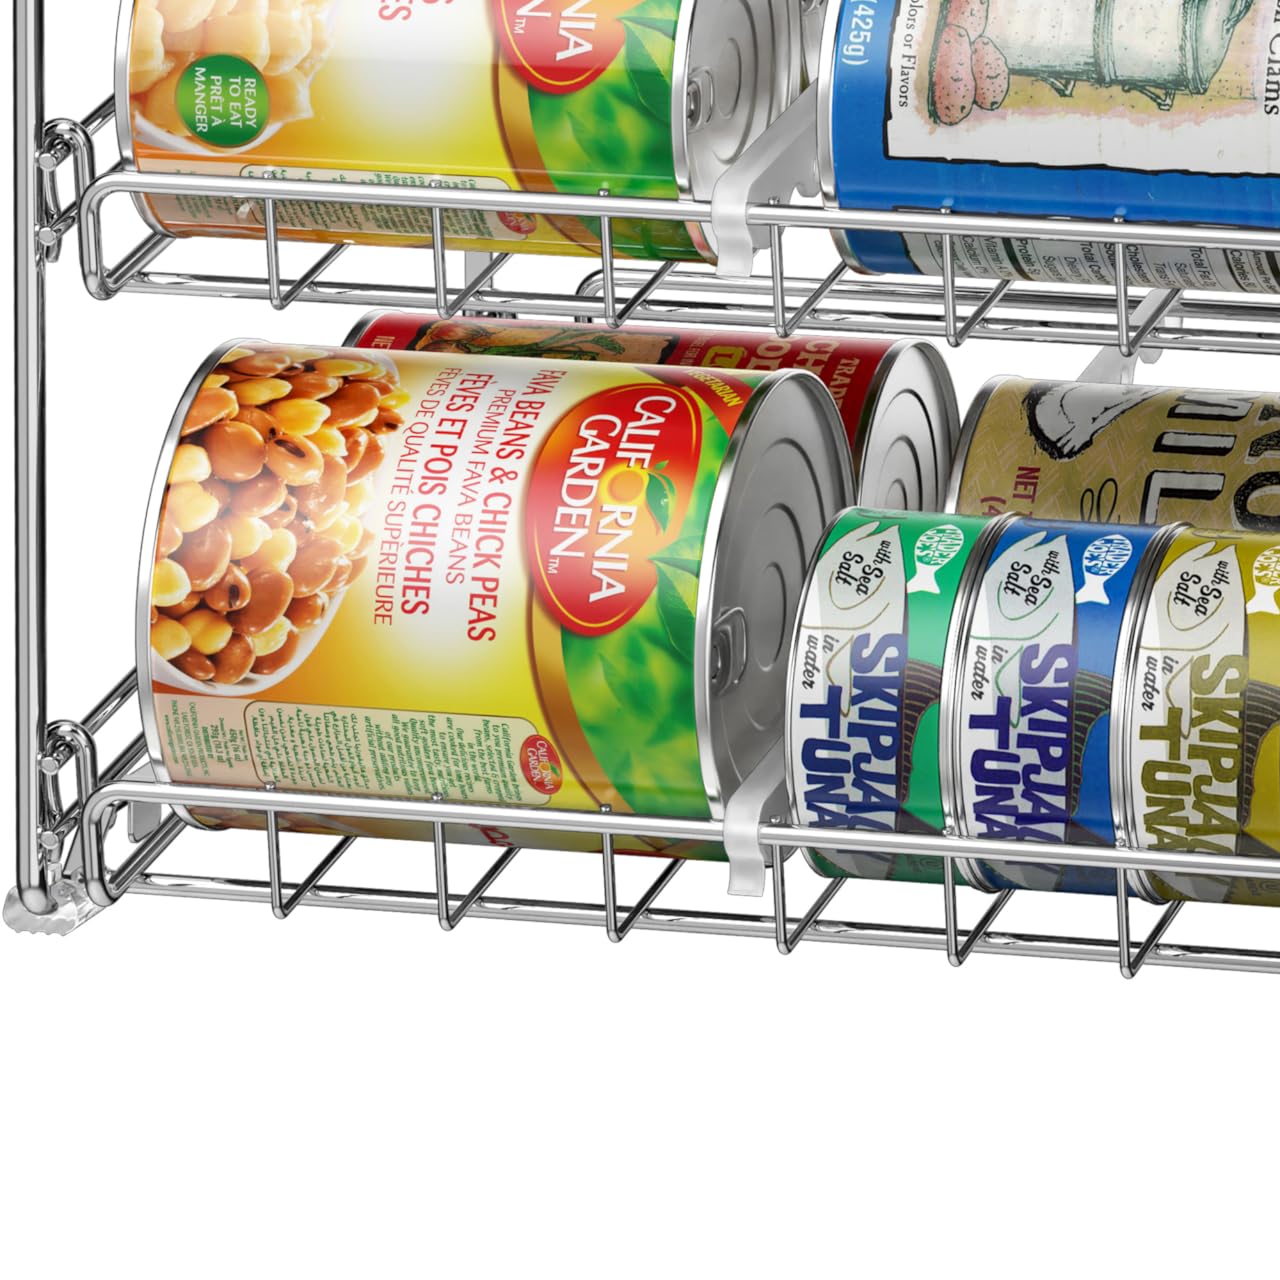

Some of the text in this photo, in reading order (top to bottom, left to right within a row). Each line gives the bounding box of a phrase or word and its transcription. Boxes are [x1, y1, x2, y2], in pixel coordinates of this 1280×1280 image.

[902, 34, 914, 49] or
[194, 66, 209, 133] MANGER
[209, 75, 224, 116] PRÊT
[228, 76, 243, 128] TO EAT
[243, 77, 259, 128] READY
[898, 54, 918, 108] Flavors
[416, 398, 440, 419] DE
[427, 367, 462, 396] FÈVES
[391, 421, 430, 495] QUALITÉ
[1011, 465, 1040, 503] NET
[401, 372, 497, 615] FÈVES ET POIS CHICHES
[445, 388, 516, 585] PREMIUM FAVA BEANS
[467, 369, 568, 642] FAVA BEANS & CHICK PEAS
[550, 414, 622, 557] GARDEN
[589, 395, 676, 603] CALIFORNIA
[835, 551, 862, 585] Salt
[856, 540, 893, 595] with Sea
[1002, 561, 1030, 596] Salt
[1023, 550, 1060, 606] with Sea
[1173, 572, 1200, 606] Salt
[1194, 560, 1231, 617] with Sea
[802, 635, 819, 689] water
[822, 635, 840, 652] in
[991, 645, 1008, 664] in
[1161, 656, 1178, 675] in
[970, 645, 990, 700] water
[1141, 656, 1159, 712] water
[799, 685, 852, 828] TUNA
[968, 696, 1021, 838] TUNA
[1139, 707, 1192, 851] TUNA
